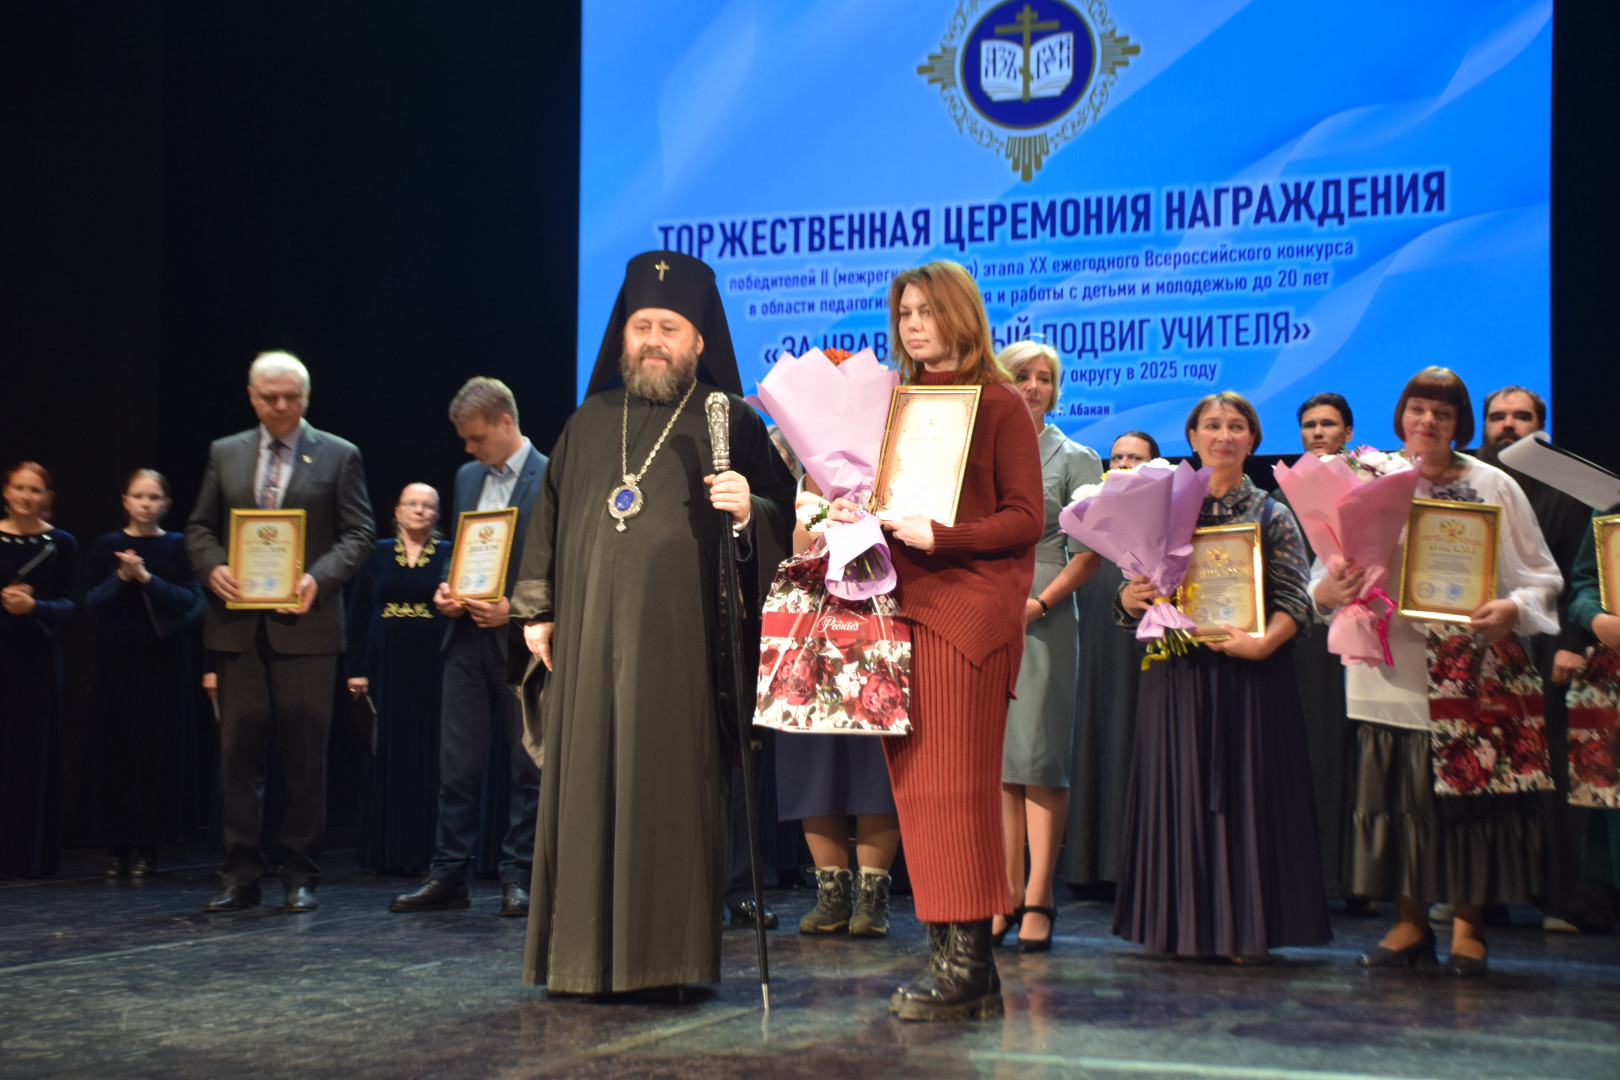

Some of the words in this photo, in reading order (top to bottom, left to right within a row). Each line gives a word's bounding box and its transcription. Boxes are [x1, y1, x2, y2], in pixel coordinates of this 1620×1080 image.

[658, 209, 931, 259] ТОРЖЕСТВЕННАЯ
[944, 194, 1151, 251] ЦЕРЕМОНИЯ
[1166, 171, 1446, 231] НАГРАЖДЕНИЯ
[729, 270, 816, 292] победителей
[983, 260, 1024, 277] этапа
[1052, 253, 1140, 275] ежегодного
[1144, 244, 1272, 270] Всероссийского
[1277, 241, 1354, 262] конкурса
[749, 304, 757, 316] в
[761, 300, 816, 316] области
[997, 291, 1006, 303] и
[1011, 285, 1064, 307] работы
[1069, 288, 1078, 300] с
[1082, 282, 1136, 301] детьми
[1141, 282, 1151, 295] и
[1155, 276, 1248, 295] молодежью
[1252, 274, 1273, 291] до
[1278, 268, 1298, 288] 20
[1302, 271, 1330, 286] лет
[1043, 318, 1150, 359] ПОДВИГ
[1160, 311, 1312, 350] УЧИТЕЛЯ»
[1070, 367, 1122, 386] округу
[1126, 366, 1135, 380] в
[1139, 360, 1178, 380] 2025
[1183, 363, 1218, 382] году
[1069, 402, 1110, 417] Абакан
[816, 616, 859, 633] Peonies
